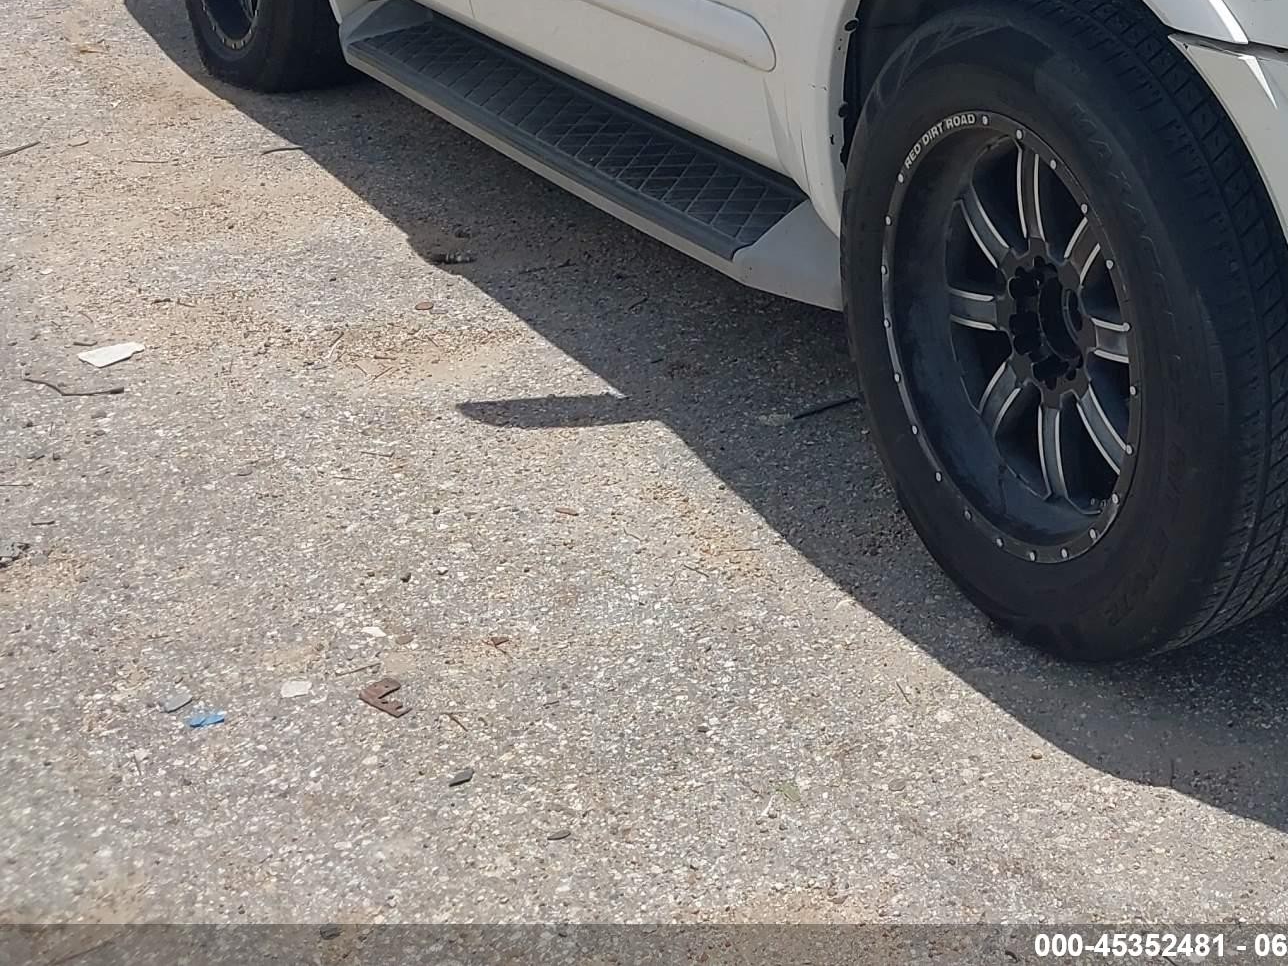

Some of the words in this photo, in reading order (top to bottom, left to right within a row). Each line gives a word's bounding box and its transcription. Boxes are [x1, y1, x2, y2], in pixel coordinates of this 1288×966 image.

[904, 142, 922, 169] RED
[921, 124, 945, 146] DIRT
[945, 113, 976, 130] ROAD
